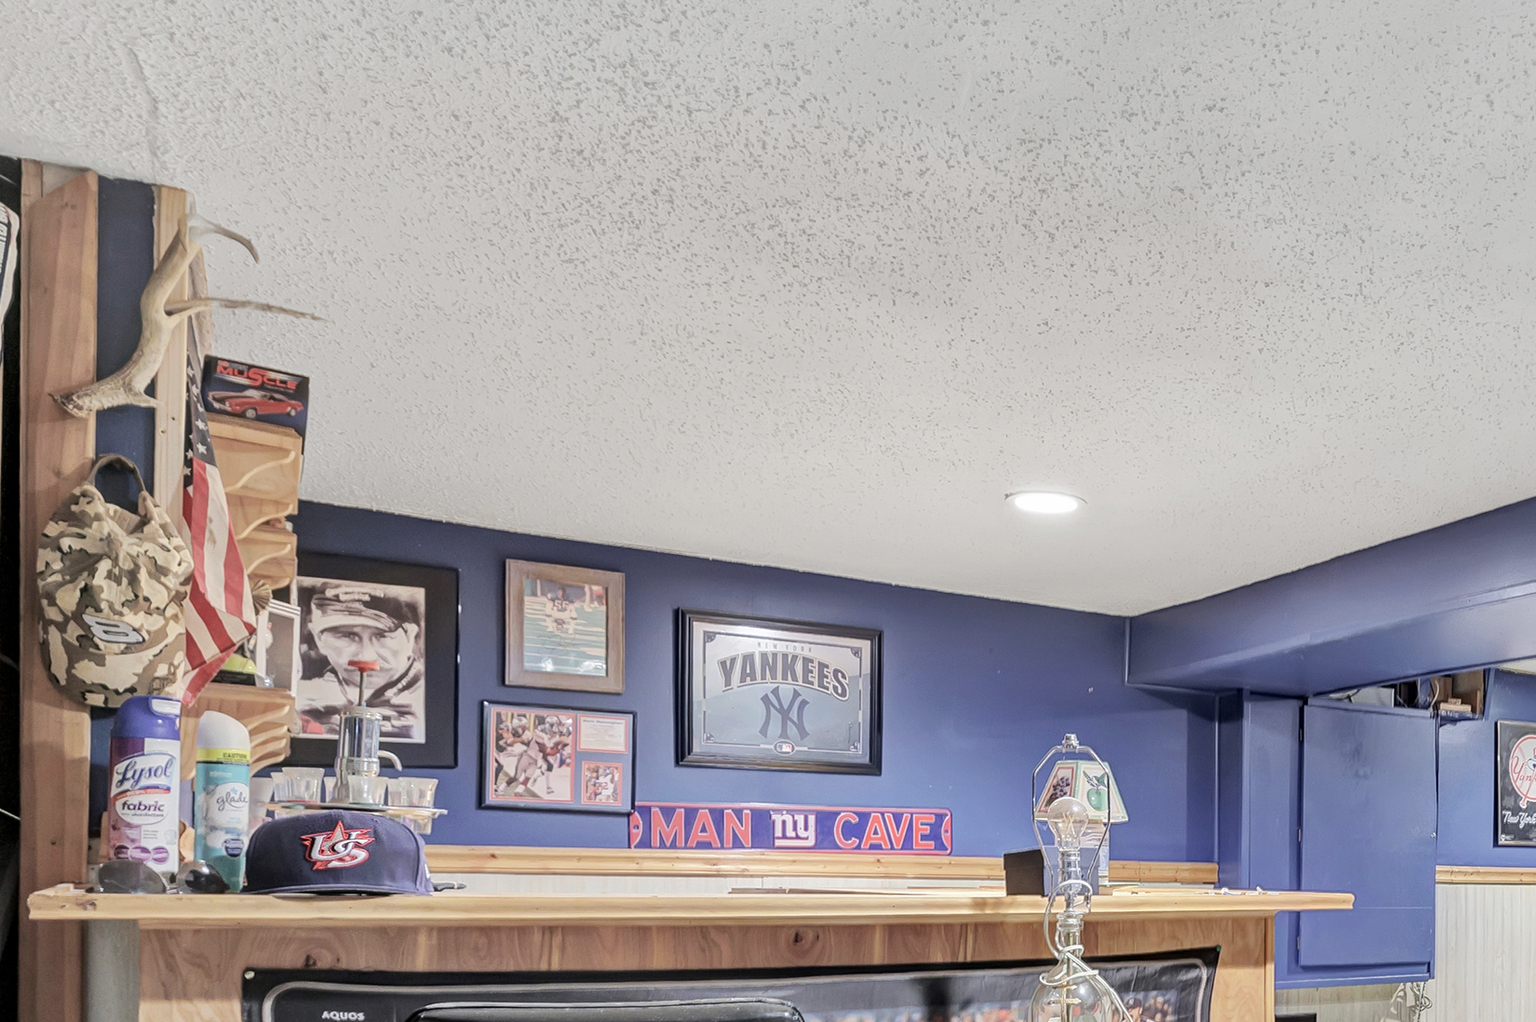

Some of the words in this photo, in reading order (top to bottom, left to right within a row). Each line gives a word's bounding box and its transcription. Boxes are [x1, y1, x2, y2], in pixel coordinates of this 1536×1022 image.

[757, 641, 778, 650] NEW
[785, 644, 812, 653] YORK
[717, 650, 850, 702] YANKEES
[116, 756, 174, 788] Lysol
[121, 800, 165, 812] fabric
[216, 790, 248, 812] glade
[650, 807, 752, 848] MAN
[833, 812, 936, 850] CAVE
[321, 1010, 365, 1021] AQUOS
